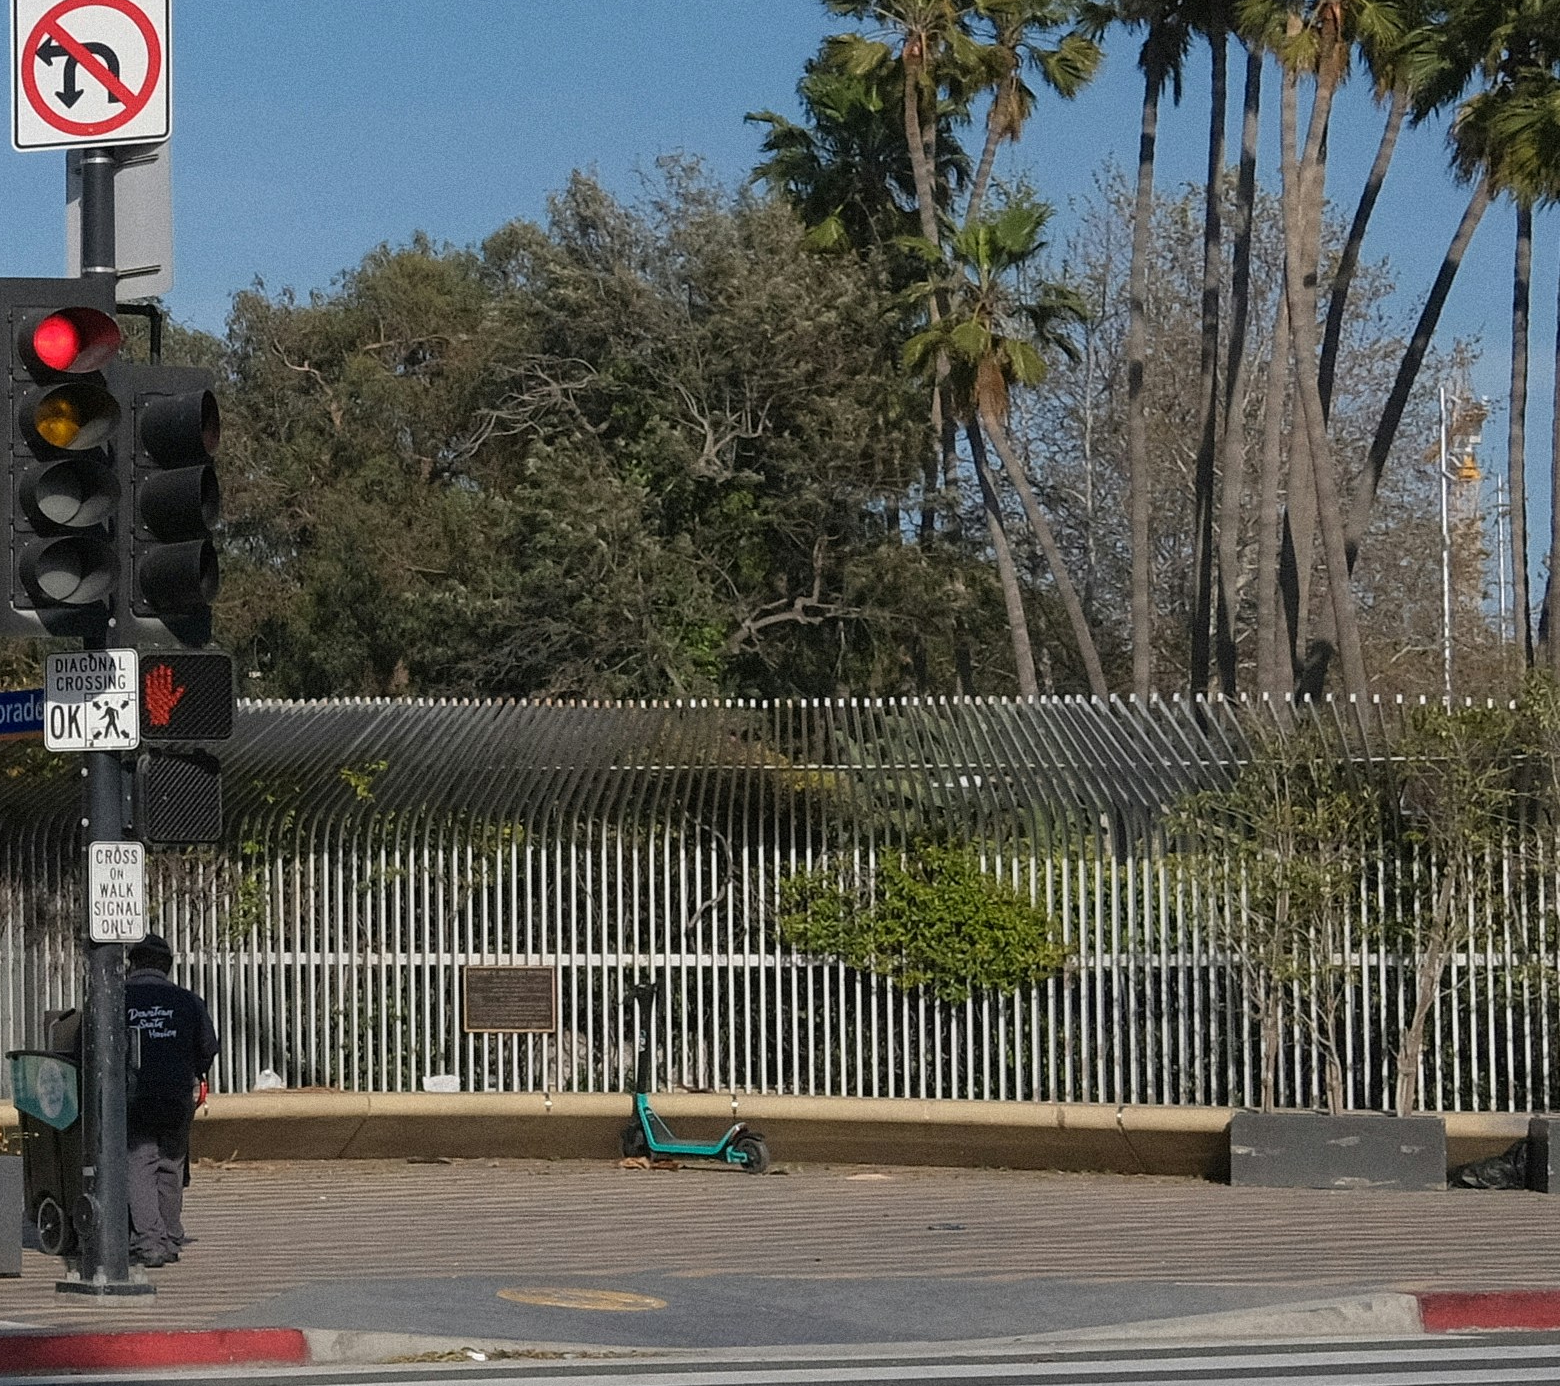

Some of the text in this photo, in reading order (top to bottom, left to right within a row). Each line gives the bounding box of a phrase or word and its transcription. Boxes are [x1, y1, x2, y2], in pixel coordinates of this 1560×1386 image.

[55, 655, 127, 673] DIAGONAL
[56, 674, 127, 692] CROSSING
[50, 704, 82, 740] OK
[95, 849, 138, 865] CROSS
[109, 867, 124, 881] ON
[99, 882, 134, 898] WALK
[94, 901, 141, 917] SIGNAL
[101, 918, 134, 934] ONLY
